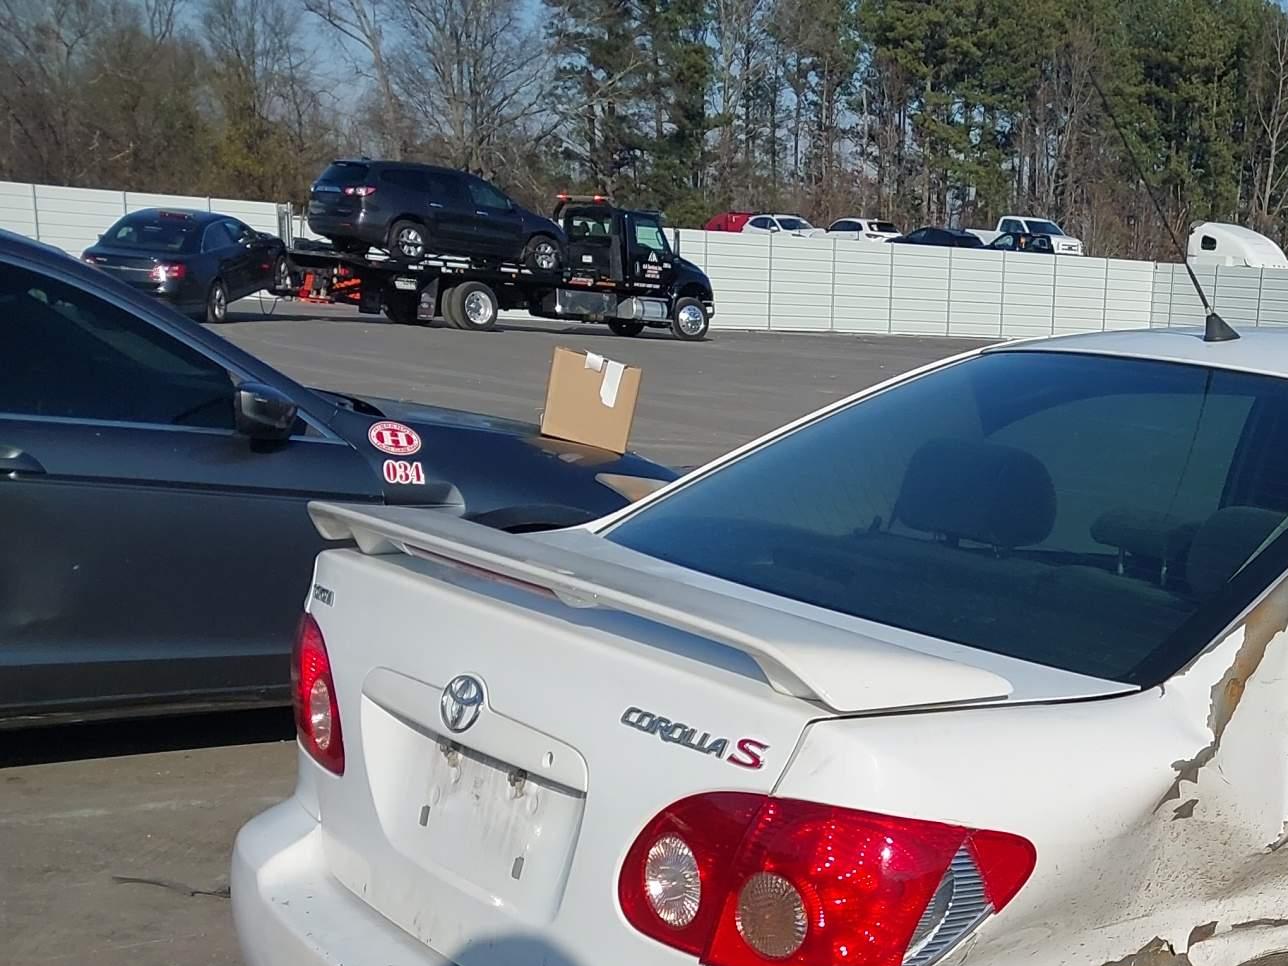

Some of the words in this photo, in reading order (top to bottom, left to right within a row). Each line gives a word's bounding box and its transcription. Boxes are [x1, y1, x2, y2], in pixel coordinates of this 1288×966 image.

[381, 430, 409, 449] H
[383, 459, 426, 485] 034
[620, 706, 730, 759] COROLLA
[726, 738, 770, 770] S
